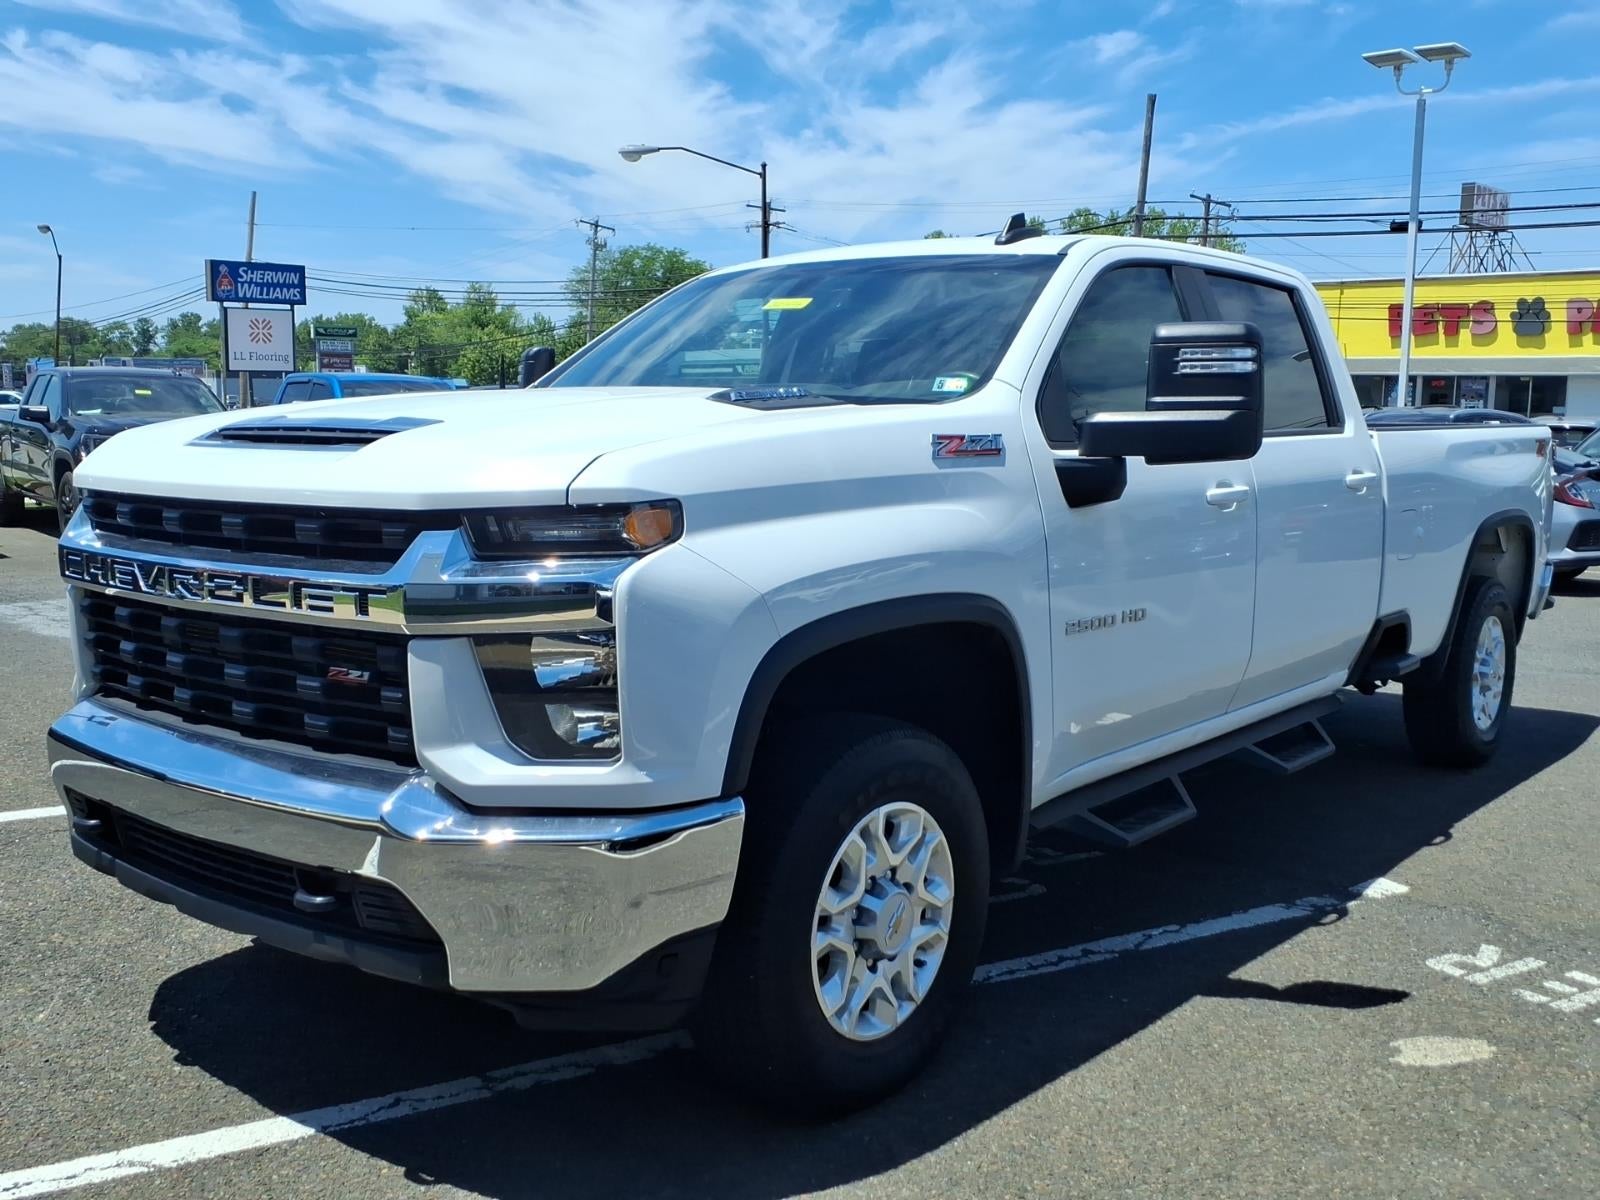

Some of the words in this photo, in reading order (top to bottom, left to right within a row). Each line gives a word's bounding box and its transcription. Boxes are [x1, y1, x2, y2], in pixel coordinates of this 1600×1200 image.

[237, 266, 300, 285] SHERWIN
[237, 282, 301, 300] WILLIAMS
[1388, 300, 1497, 337] PETS
[1566, 297, 1600, 336] P
[233, 351, 247, 361] LL
[249, 351, 290, 364] Flooring
[931, 433, 1003, 458] Z71
[63, 550, 388, 619] CHEVROLET
[1065, 614, 1117, 636] 2500
[1121, 608, 1148, 624] HD
